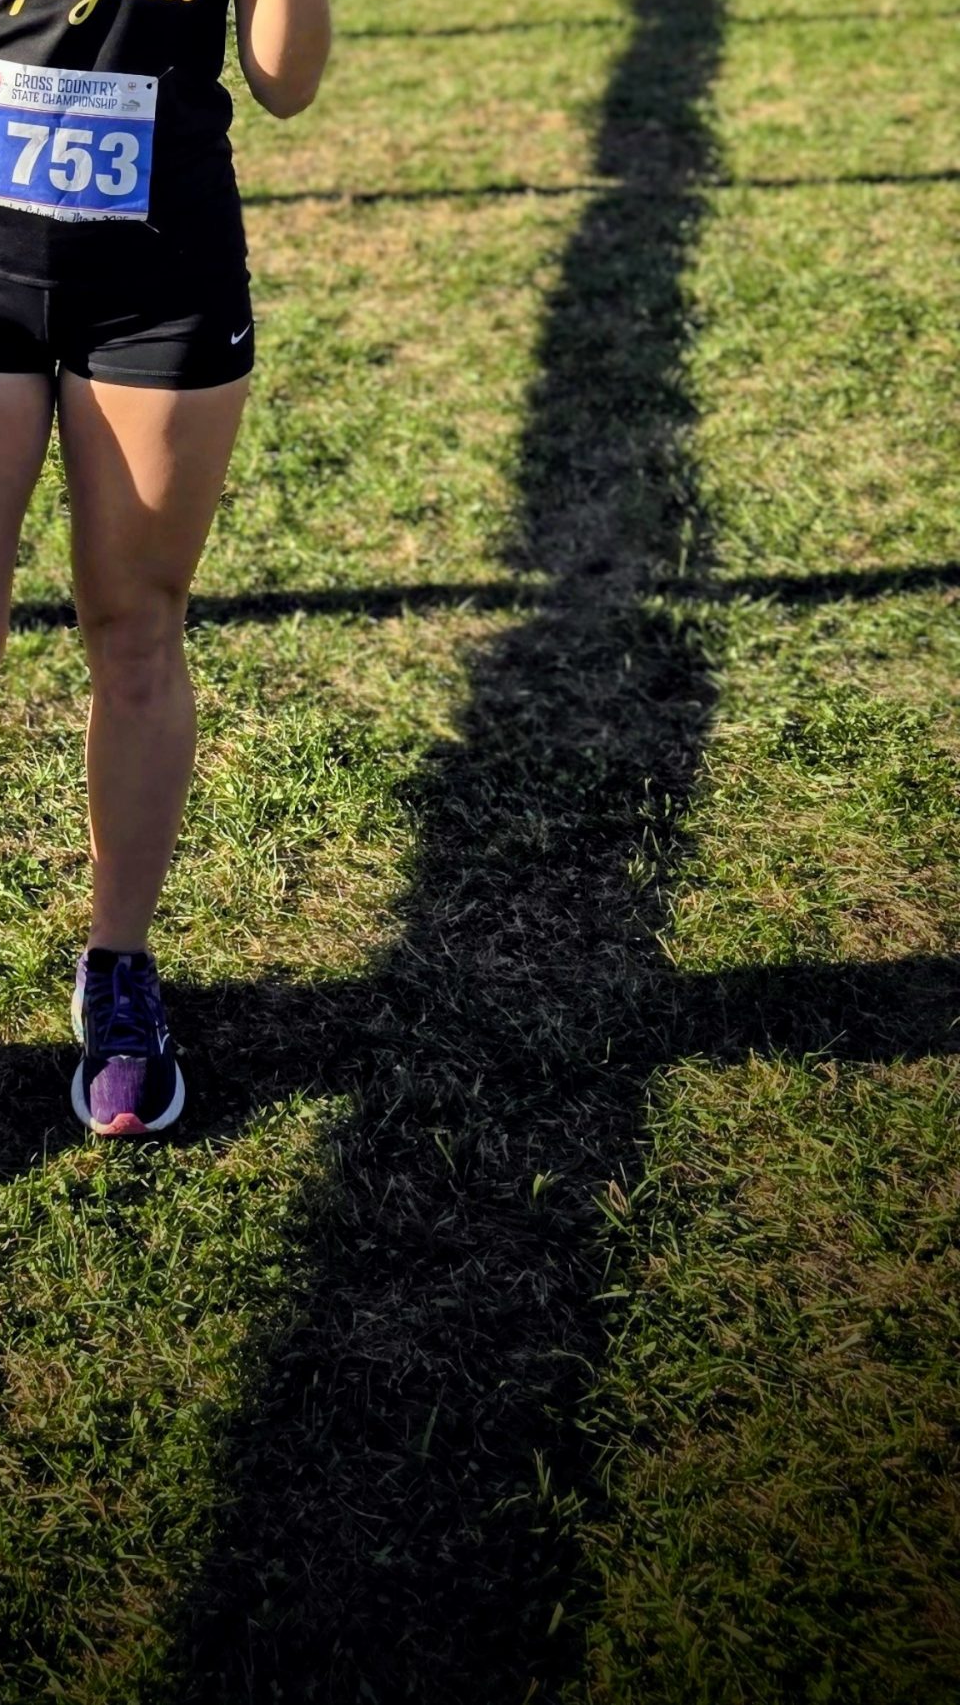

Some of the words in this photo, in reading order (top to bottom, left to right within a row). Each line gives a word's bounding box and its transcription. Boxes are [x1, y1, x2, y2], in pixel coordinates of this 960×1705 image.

[14, 72, 53, 91] CROSS
[58, 78, 118, 97] COUNTRY
[11, 88, 39, 103] STATE
[42, 92, 118, 110] CHAMPIONSHIP
